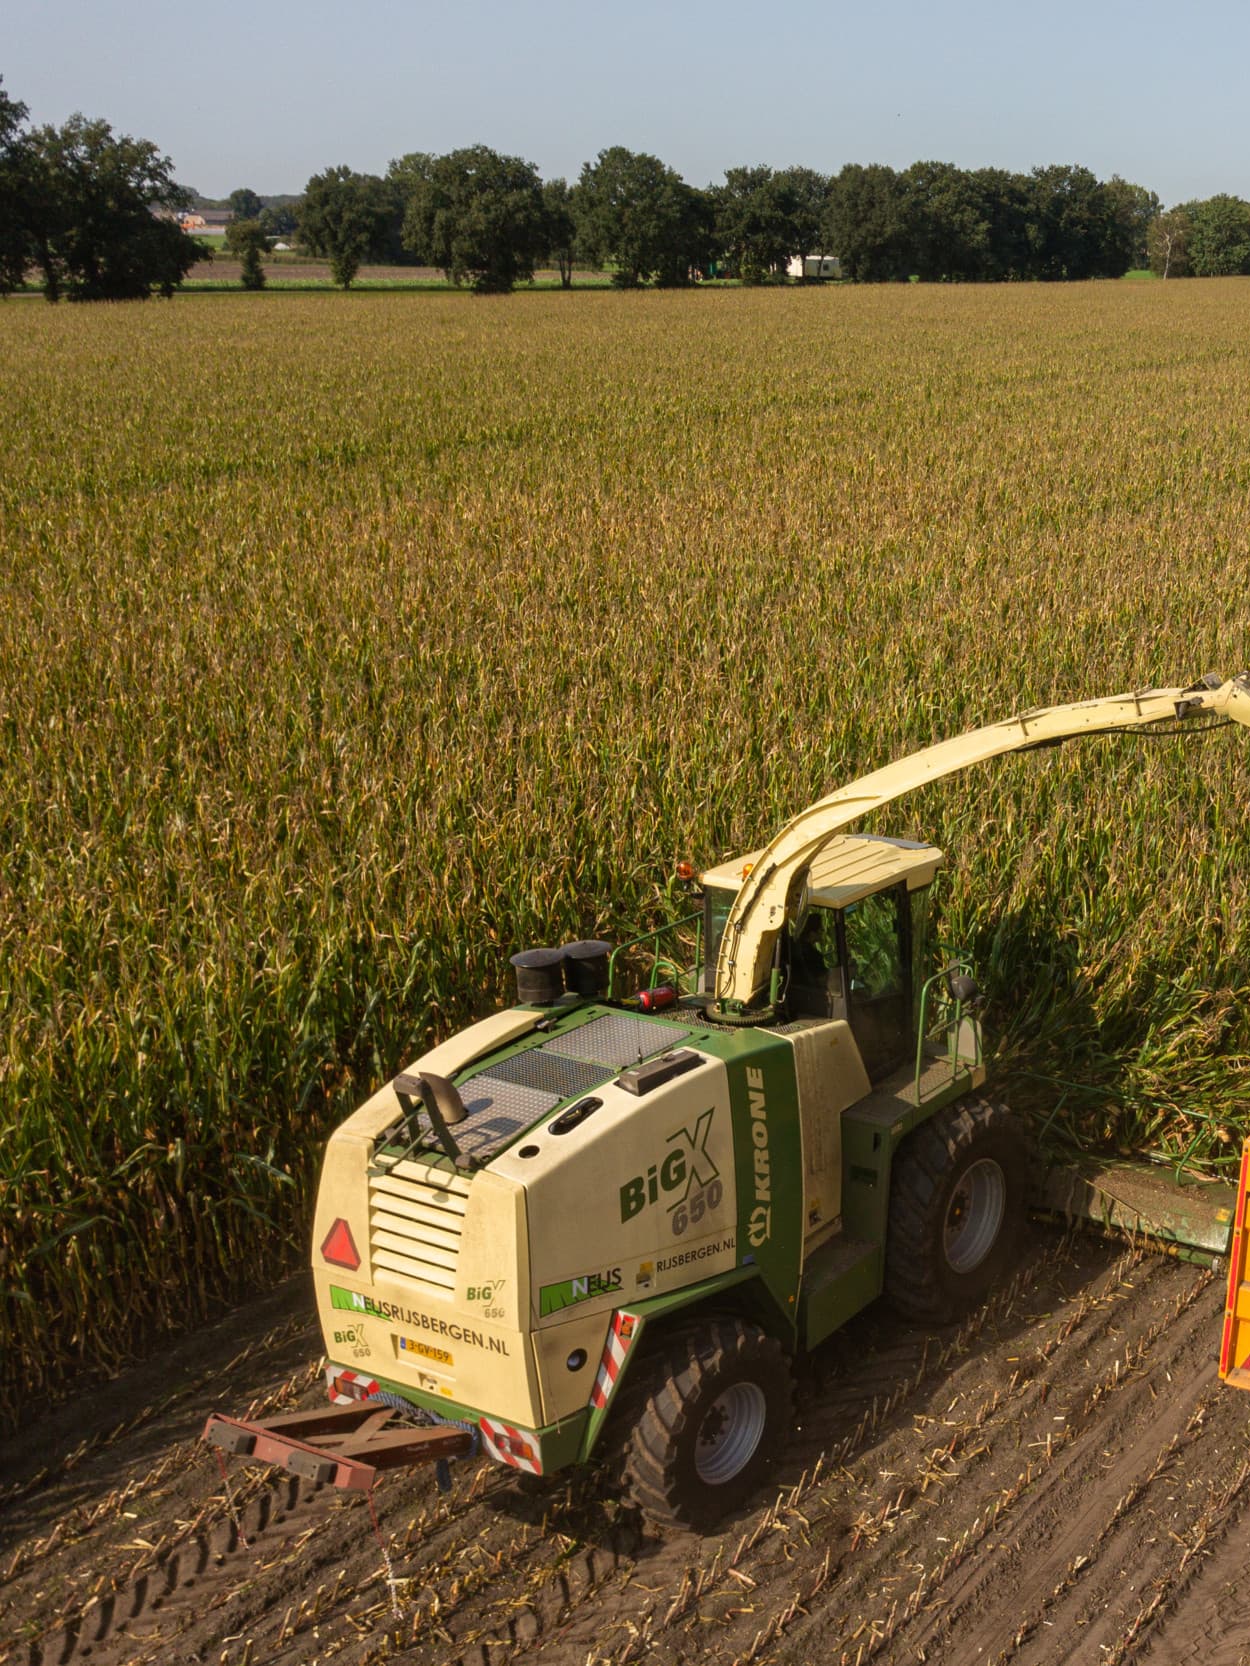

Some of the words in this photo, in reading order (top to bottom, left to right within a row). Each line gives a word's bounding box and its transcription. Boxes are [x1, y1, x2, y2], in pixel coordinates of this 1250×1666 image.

[746, 1066, 771, 1201] KRONE
[672, 1180, 723, 1236] 650
[572, 1268, 622, 1297] NEIJS
[656, 1237, 736, 1273] RIJSBERGEN.NL
[484, 1307, 505, 1319] 650
[353, 1347, 371, 1358] 650
